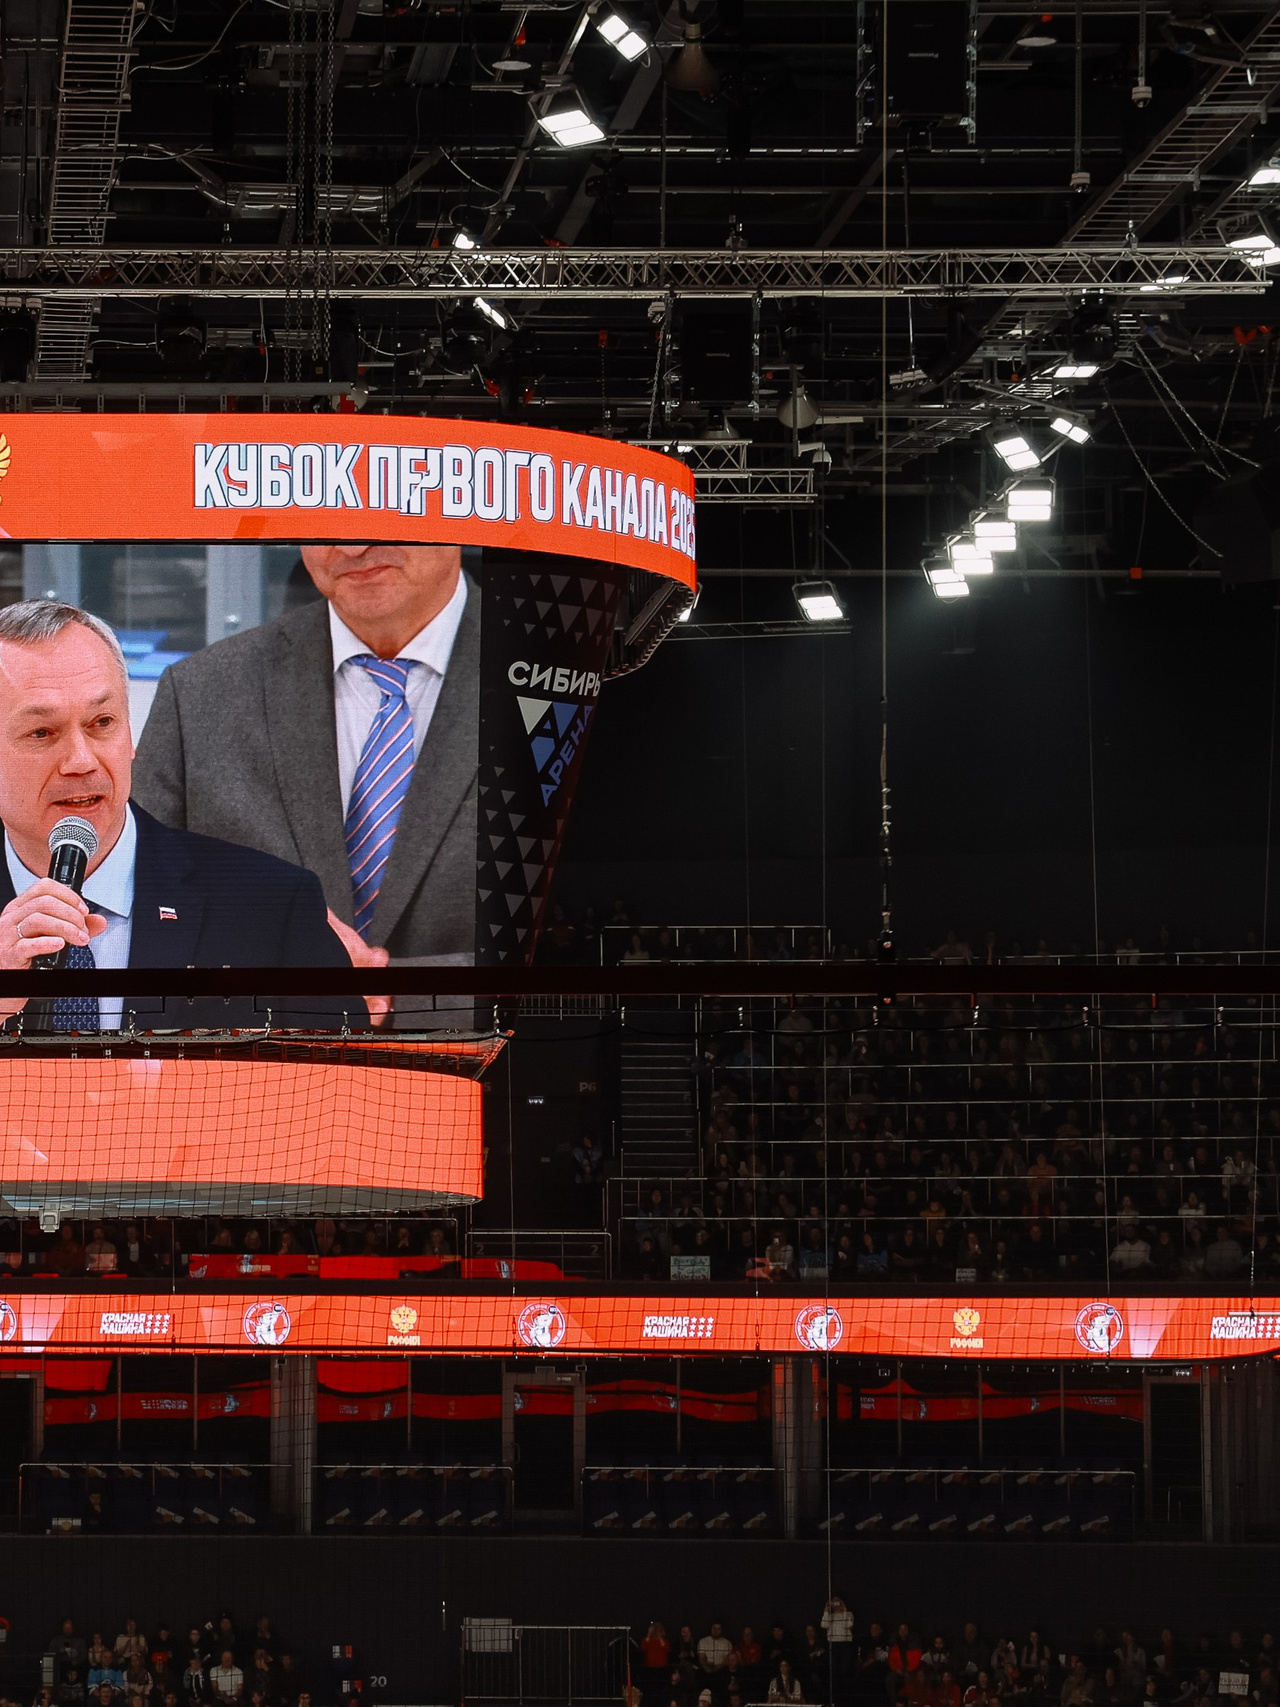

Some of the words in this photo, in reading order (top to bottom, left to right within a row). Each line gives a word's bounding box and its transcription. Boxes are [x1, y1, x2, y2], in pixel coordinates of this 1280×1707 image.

[194, 443, 363, 509] КУБОК
[562, 460, 670, 547] КАНАЛА
[507, 661, 601, 697] СИБИРЬ
[540, 705, 595, 807] АРЕНА
[101, 1312, 146, 1323] КРАСНАЯ
[644, 1316, 690, 1326] КРАСНАЯ
[99, 1322, 145, 1334] МАШИНА
[642, 1325, 688, 1338] МАШИНА
[1210, 1326, 1256, 1339] МАШИНА
[370, 1675, 387, 1688] 20
